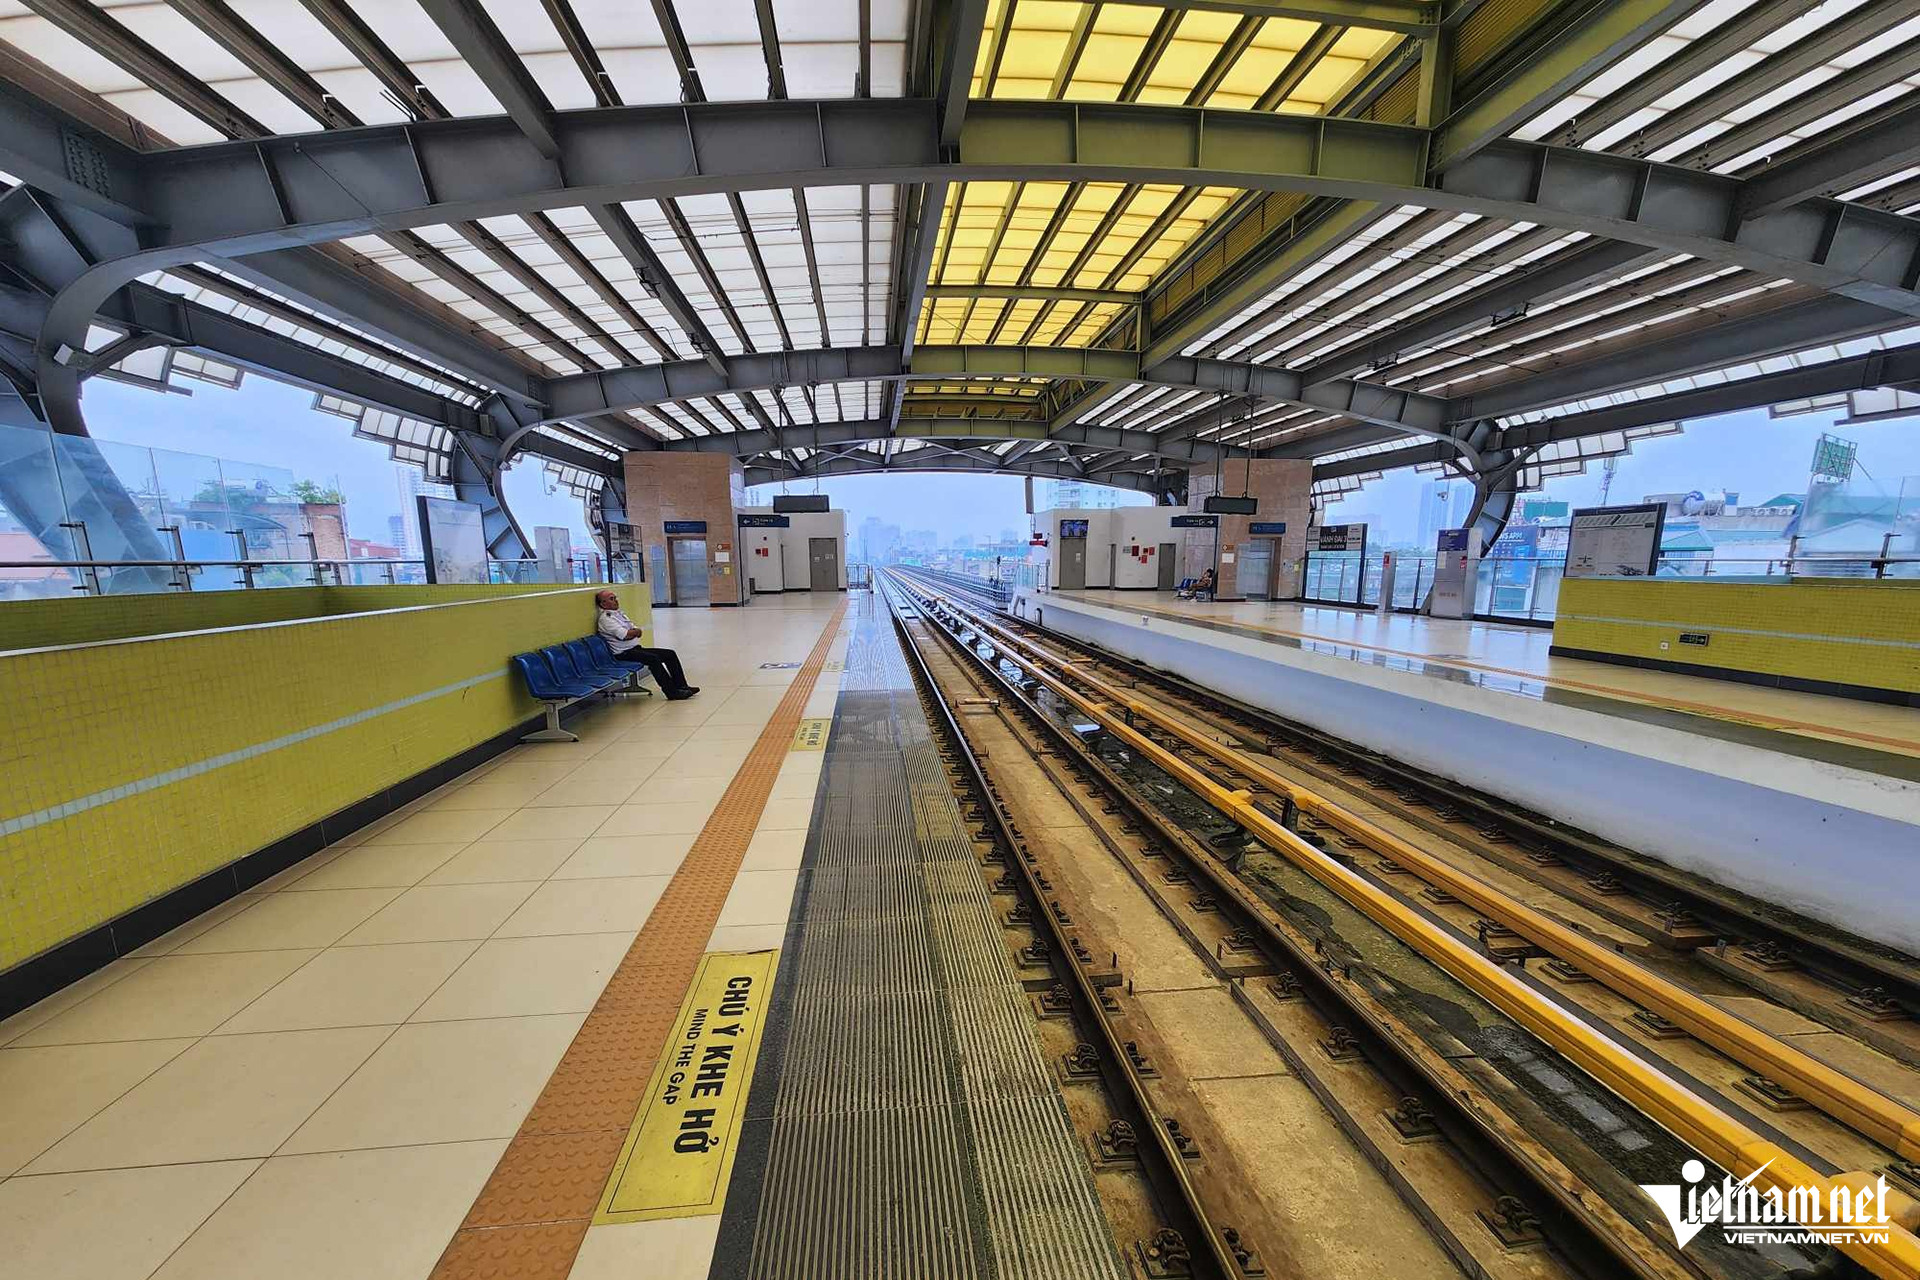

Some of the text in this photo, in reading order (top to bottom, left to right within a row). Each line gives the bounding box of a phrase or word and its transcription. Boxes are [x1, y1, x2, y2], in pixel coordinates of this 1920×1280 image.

[662, 1008, 708, 1105] MIND THE GAP
[673, 976, 753, 1154] CHÚ Ý KHE HỞ
